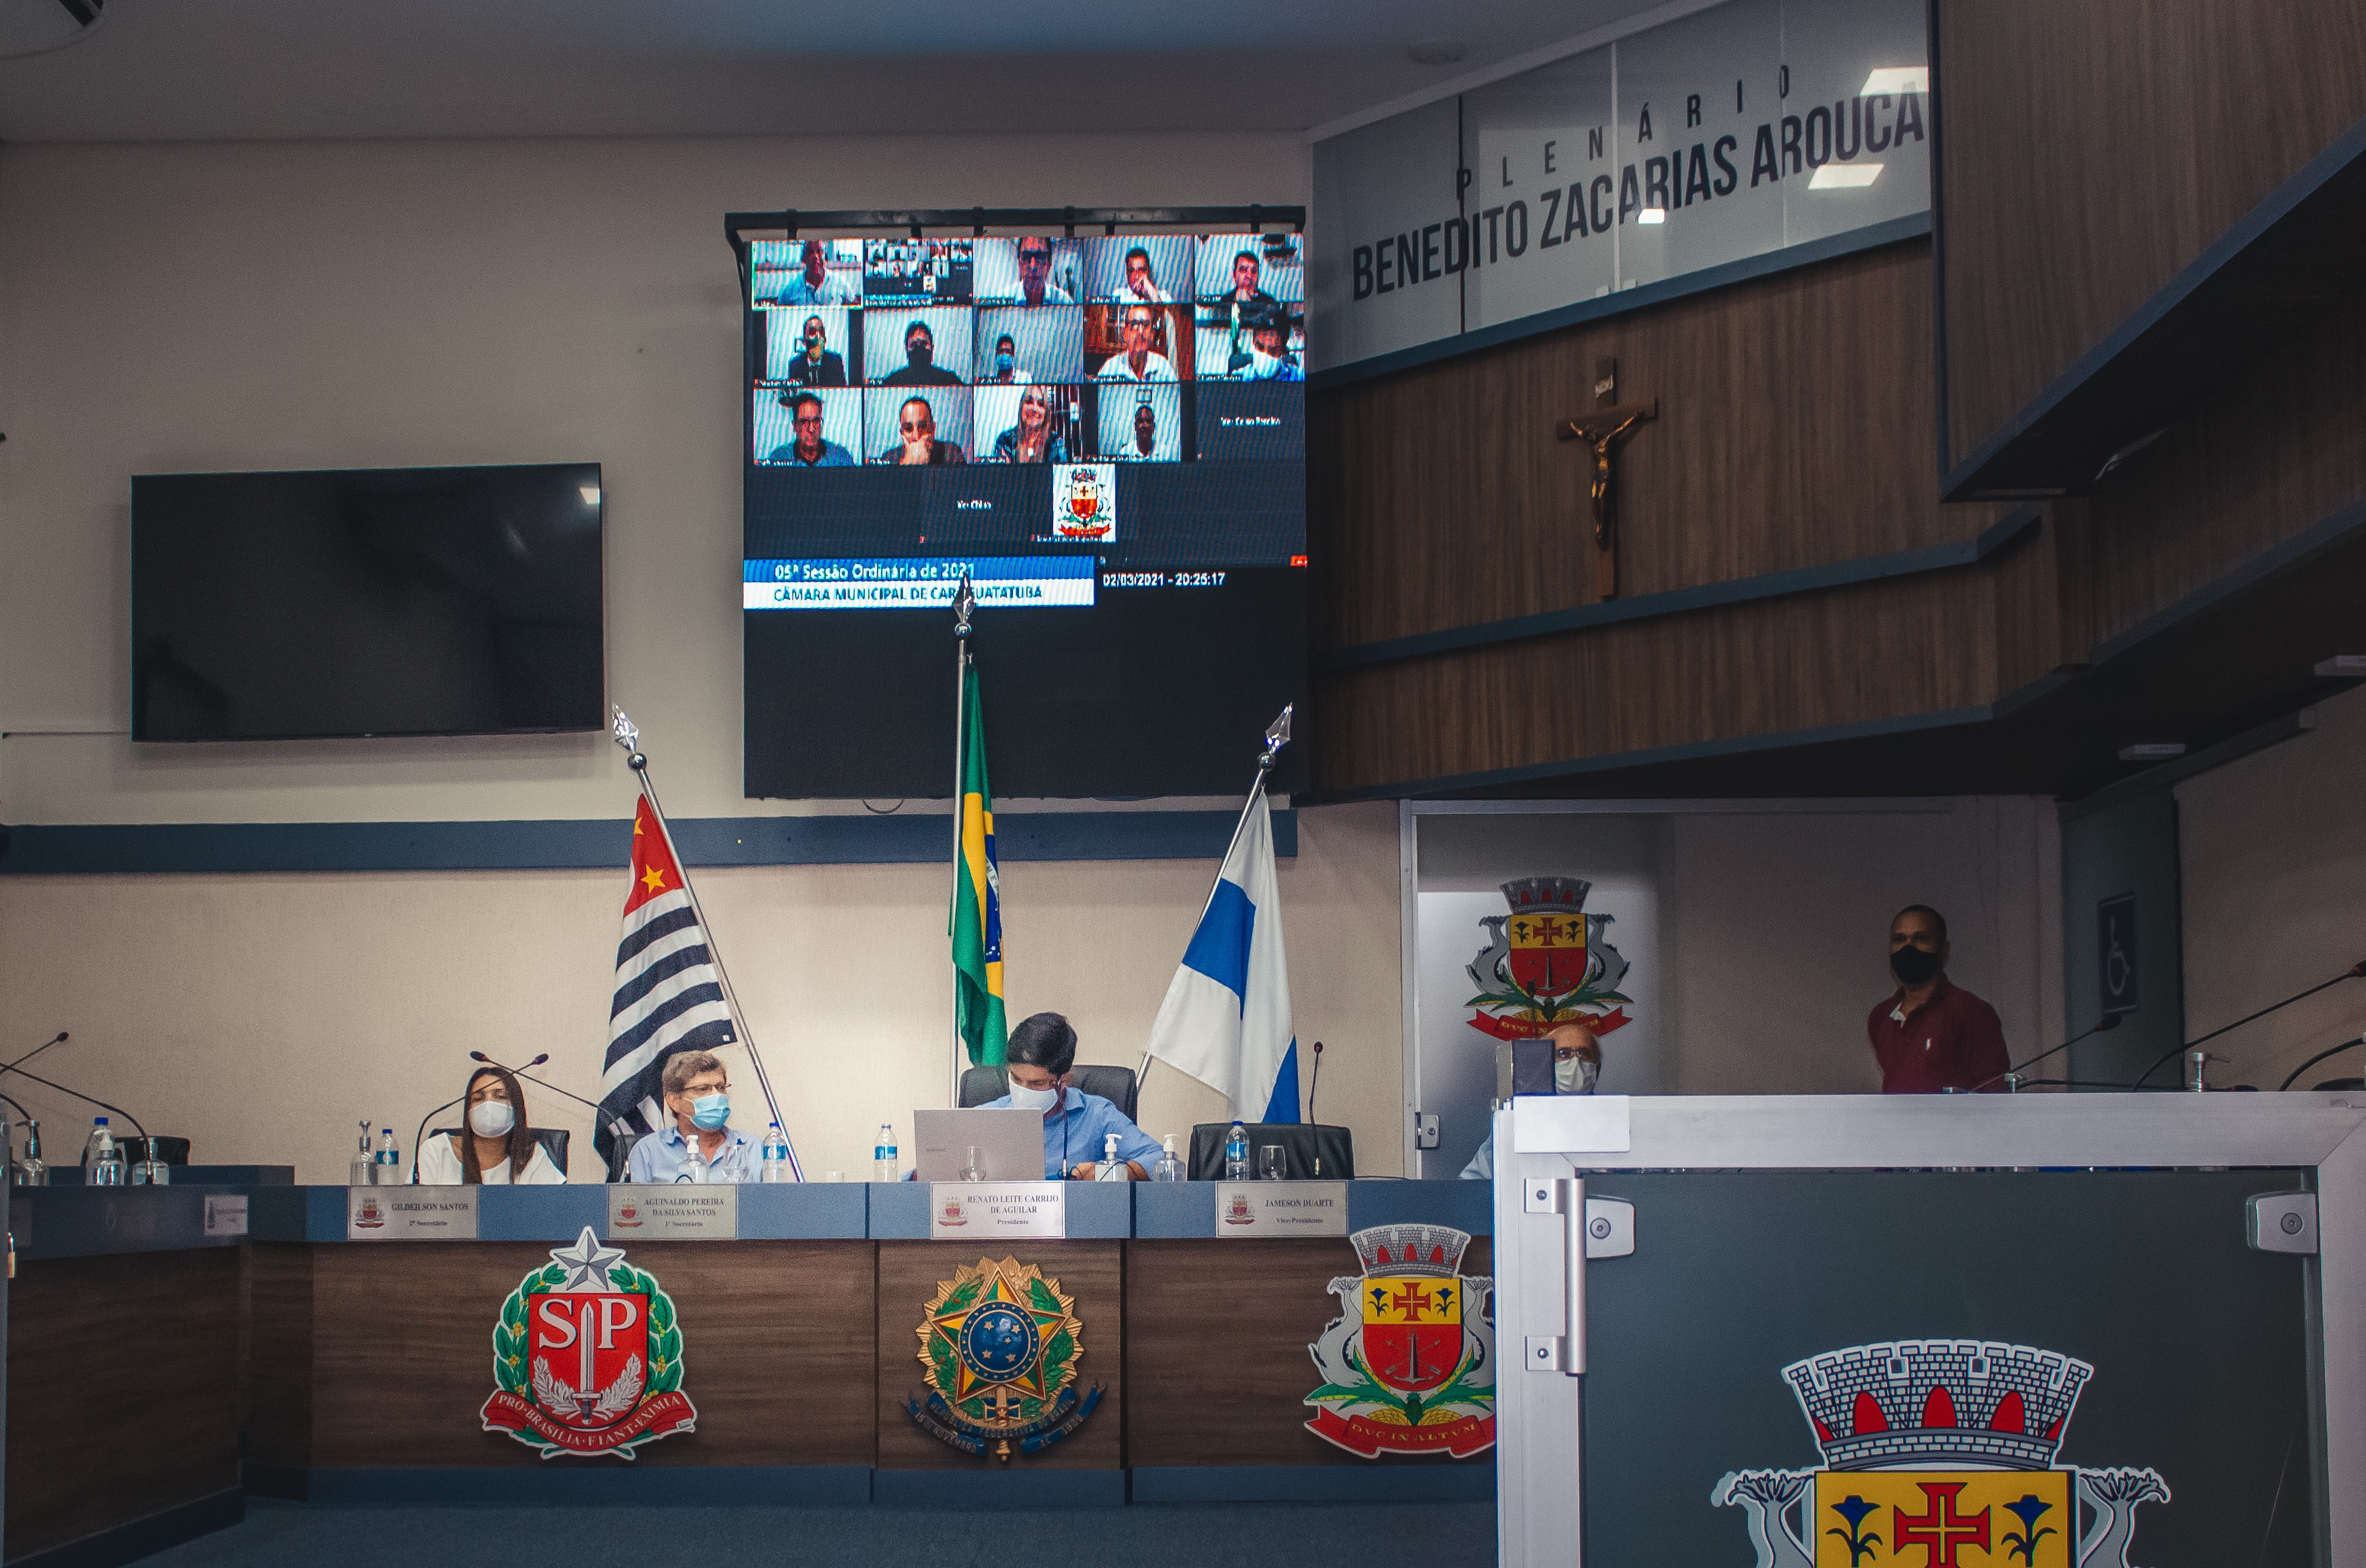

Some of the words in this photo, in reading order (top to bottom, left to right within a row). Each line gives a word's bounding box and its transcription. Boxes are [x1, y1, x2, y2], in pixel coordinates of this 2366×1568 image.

[1456, 63, 1789, 200] PLENÁRIO
[1352, 200, 1528, 300] BENEDITO
[1540, 134, 1737, 249] ZACARIAS
[1751, 80, 1925, 189] AROUCA
[803, 563, 848, 580] Sessão
[852, 562, 917, 580] Ordinária
[920, 562, 937, 578] de
[941, 562, 974, 578] 2021
[1103, 572, 1164, 588] 02/03/2021
[774, 585, 831, 601] CÂMARA
[835, 587, 907, 601] MUNICIPAL
[910, 586, 928, 600] DE
[930, 585, 1043, 600] CARUATATUBA
[1025, 1194, 1058, 1203] CARRIJO
